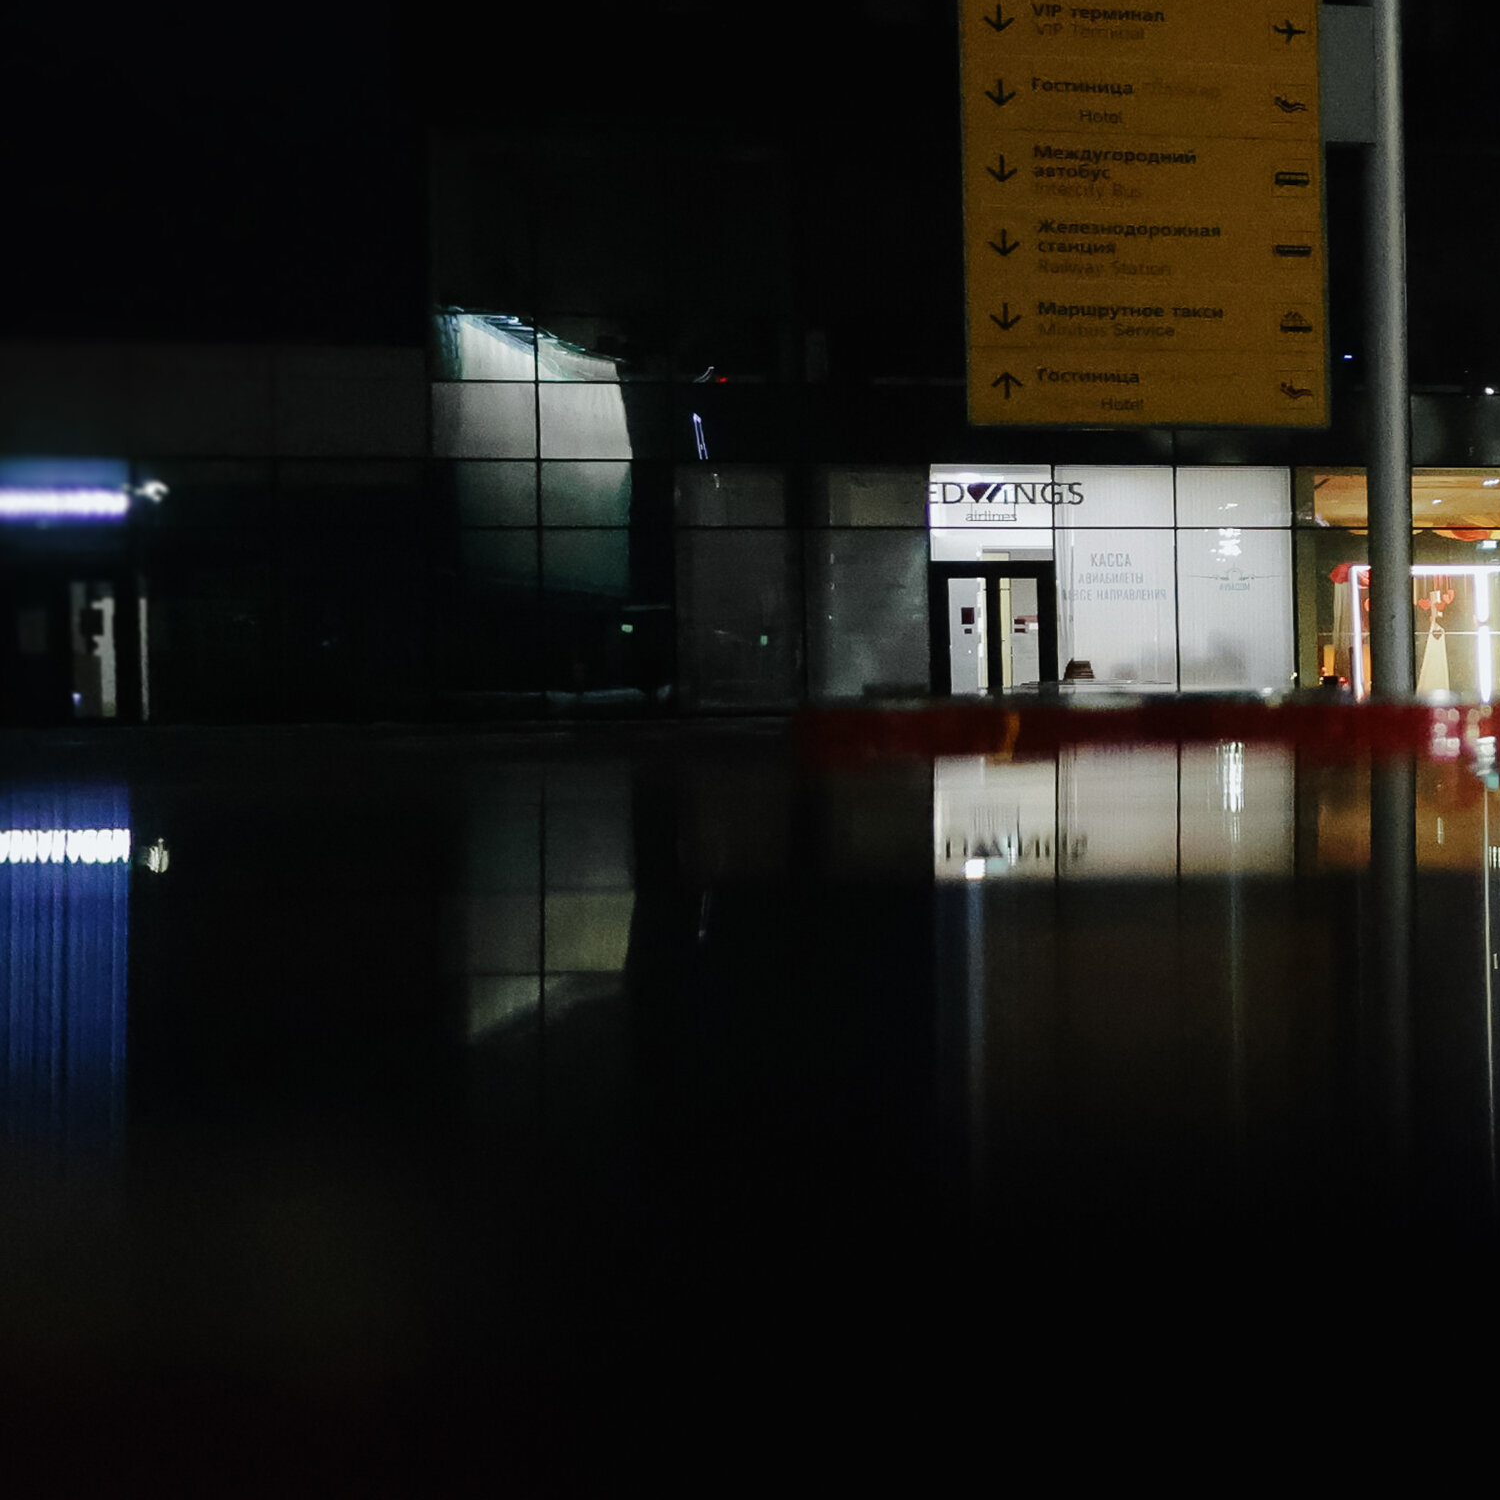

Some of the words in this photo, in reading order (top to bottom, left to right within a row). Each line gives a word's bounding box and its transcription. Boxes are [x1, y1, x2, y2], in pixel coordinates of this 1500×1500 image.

[1032, 3, 1063, 18] VIP
[1070, 7, 1165, 22] терминал
[1032, 77, 1134, 96] Гостиница
[1079, 109, 1123, 124] Hotel
[1033, 145, 1197, 164] Междугородний
[1033, 164, 1111, 180] автобус
[1037, 219, 1221, 238] Железнодорожная
[1037, 240, 1116, 255] станция
[1037, 301, 1164, 320] Маршрутное
[1171, 307, 1224, 319] такси
[1037, 368, 1140, 384] Гостиница
[965, 509, 1018, 523] airlines
[1090, 552, 1132, 568] КАССА
[1078, 572, 1144, 585] АВИАБИЛЕТЫ
[1096, 588, 1167, 602] НАПРАВЛЕНИЯ
